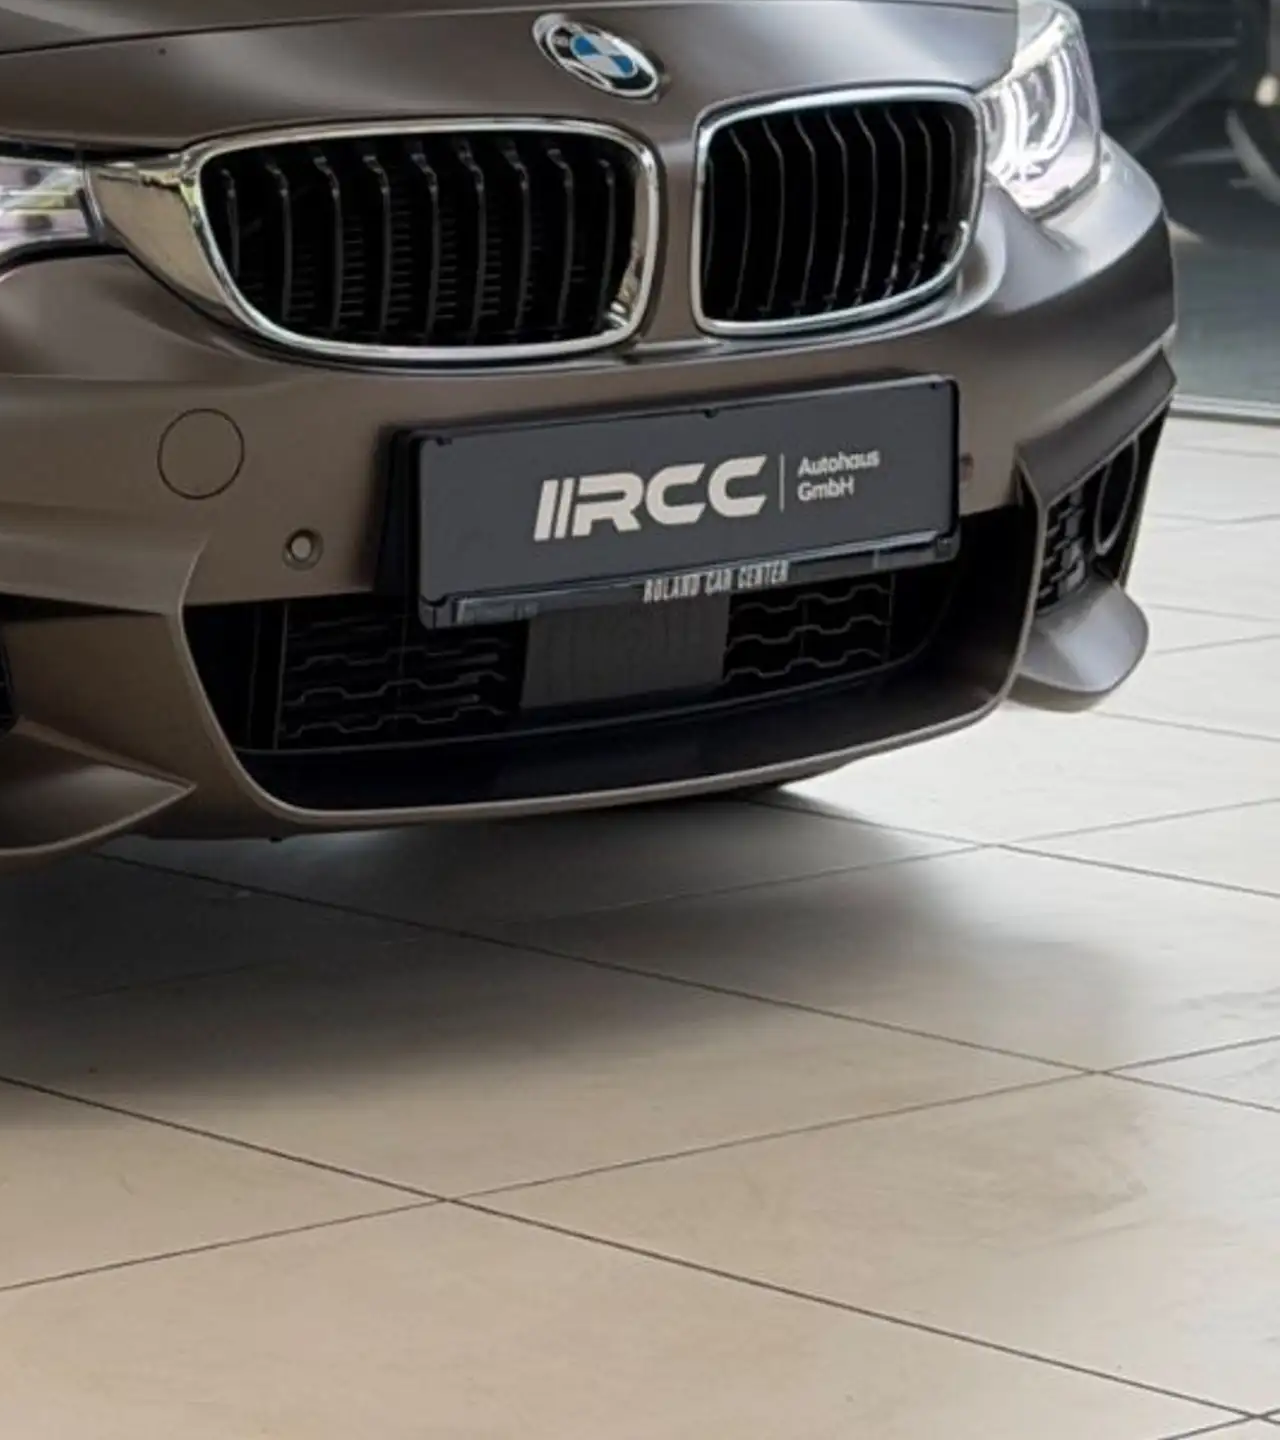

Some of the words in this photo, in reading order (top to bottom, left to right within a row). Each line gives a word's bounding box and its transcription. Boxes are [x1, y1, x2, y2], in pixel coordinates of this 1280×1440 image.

[797, 449, 882, 477] Autohaus
[797, 475, 857, 502] GmbH
[643, 574, 700, 604] ROLAND
[737, 560, 789, 589] CENTER
